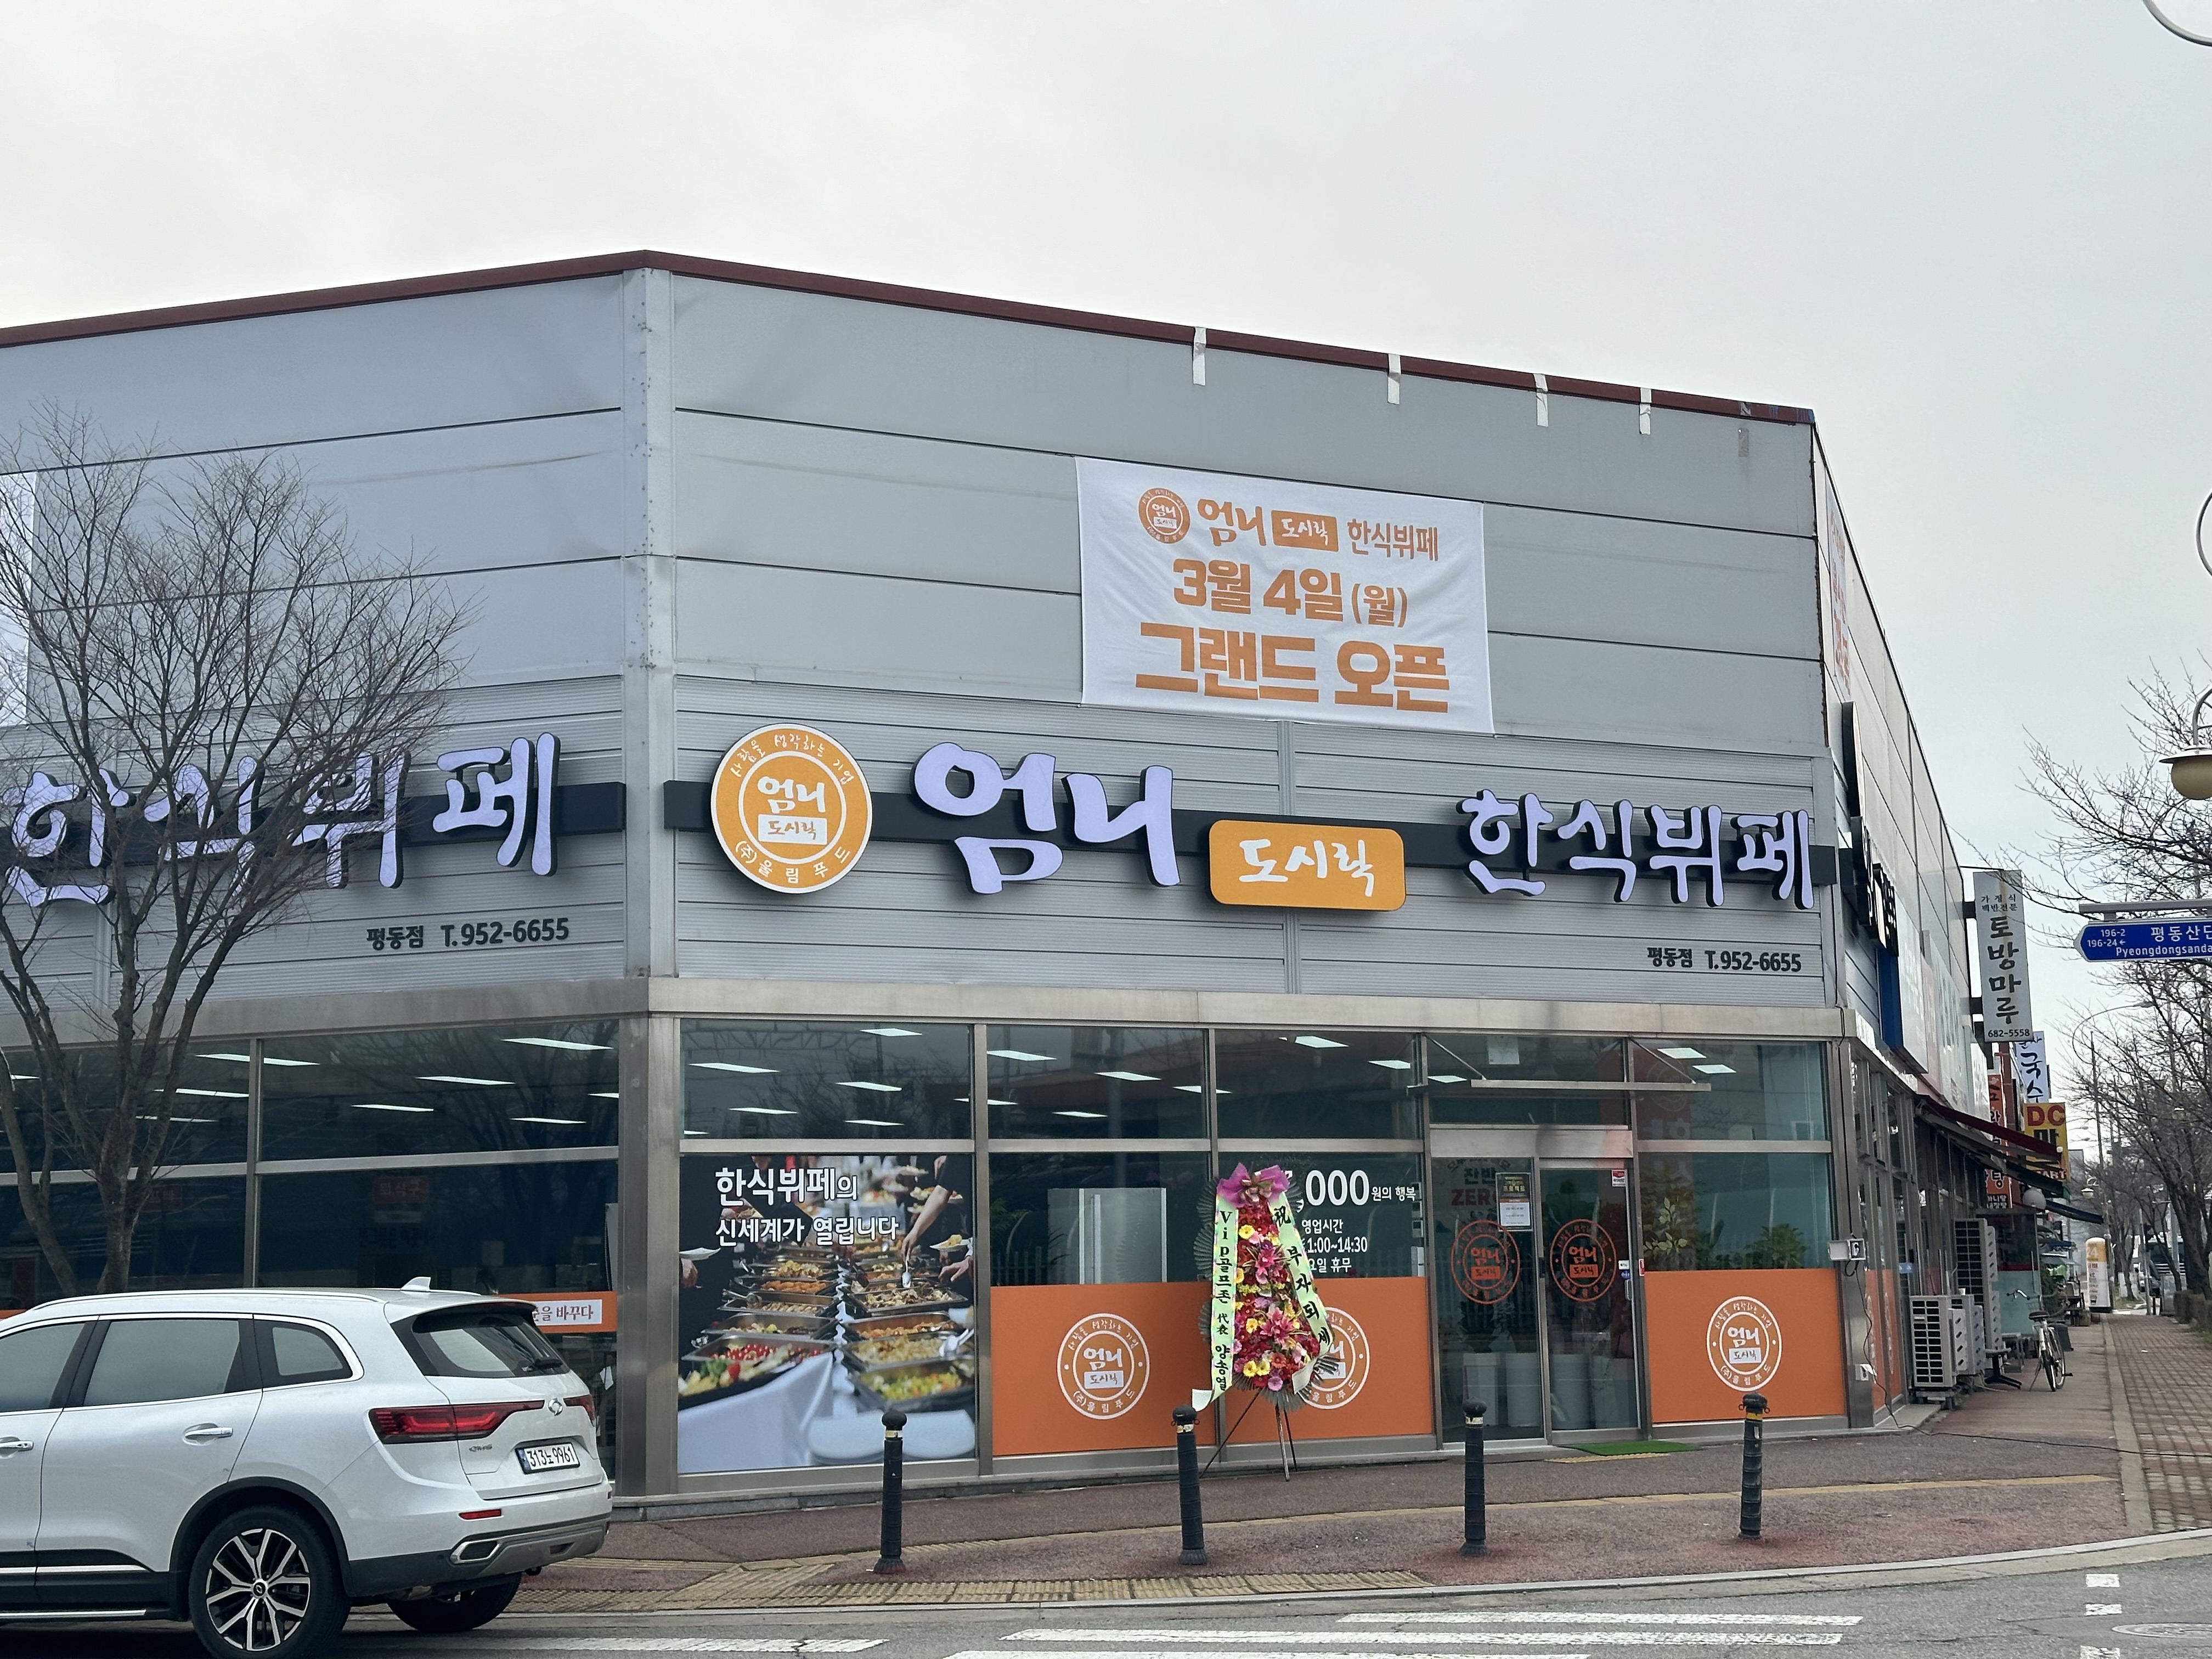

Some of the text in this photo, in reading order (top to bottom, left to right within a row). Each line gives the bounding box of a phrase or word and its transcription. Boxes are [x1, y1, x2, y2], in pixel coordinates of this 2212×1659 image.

[1197, 499, 1267, 546] 엄니
[1282, 517, 1329, 545] 도시락
[1347, 518, 1440, 561] 한식뷔페
[1172, 558, 1408, 628] 3월 4일 (월)
[1135, 622, 1450, 713] 그랜드 오픈
[774, 733, 825, 757] 생각하는
[833, 759, 854, 785] 기업
[757, 776, 826, 814] 엄니
[768, 821, 816, 840] 도시락
[913, 742, 1181, 894] 엄니
[1238, 839, 1375, 896] 도시락
[1456, 789, 1814, 909] 한식뷔페
[366, 917, 569, 951] 평동점 T.952-6655
[2087, 939, 2118, 947] 196-24
[2101, 929, 2126, 937] 196-2
[1646, 947, 1802, 972] 평동점 T.952-6655
[1987, 916, 2022, 1024] 토방마루
[1988, 1028, 2030, 1038] 682-5558
[2027, 1104, 2066, 1126] DC
[715, 1167, 858, 1207] 한식뷔페의
[1395, 1186, 1417, 1201] 행복
[1451, 1188, 1497, 1206] ZER
[1273, 1205, 1291, 1227] 祝
[1301, 1219, 1344, 1234] 영업시간
[715, 1216, 899, 1247] 신세계가 열립니다
[1302, 1236, 1368, 1254] 1:00~14:30
[1568, 1246, 1597, 1264] 엄니
[1330, 1257, 1352, 1273] 휴무
[556, 1304, 594, 1321] 바꾸다
[1728, 1327, 1760, 1347] 엄니
[1083, 1347, 1123, 1371] 엄니
[1329, 1340, 1345, 1359] 니
[1090, 1373, 1118, 1385] 도시락
[527, 1446, 575, 1468] 313노9961
